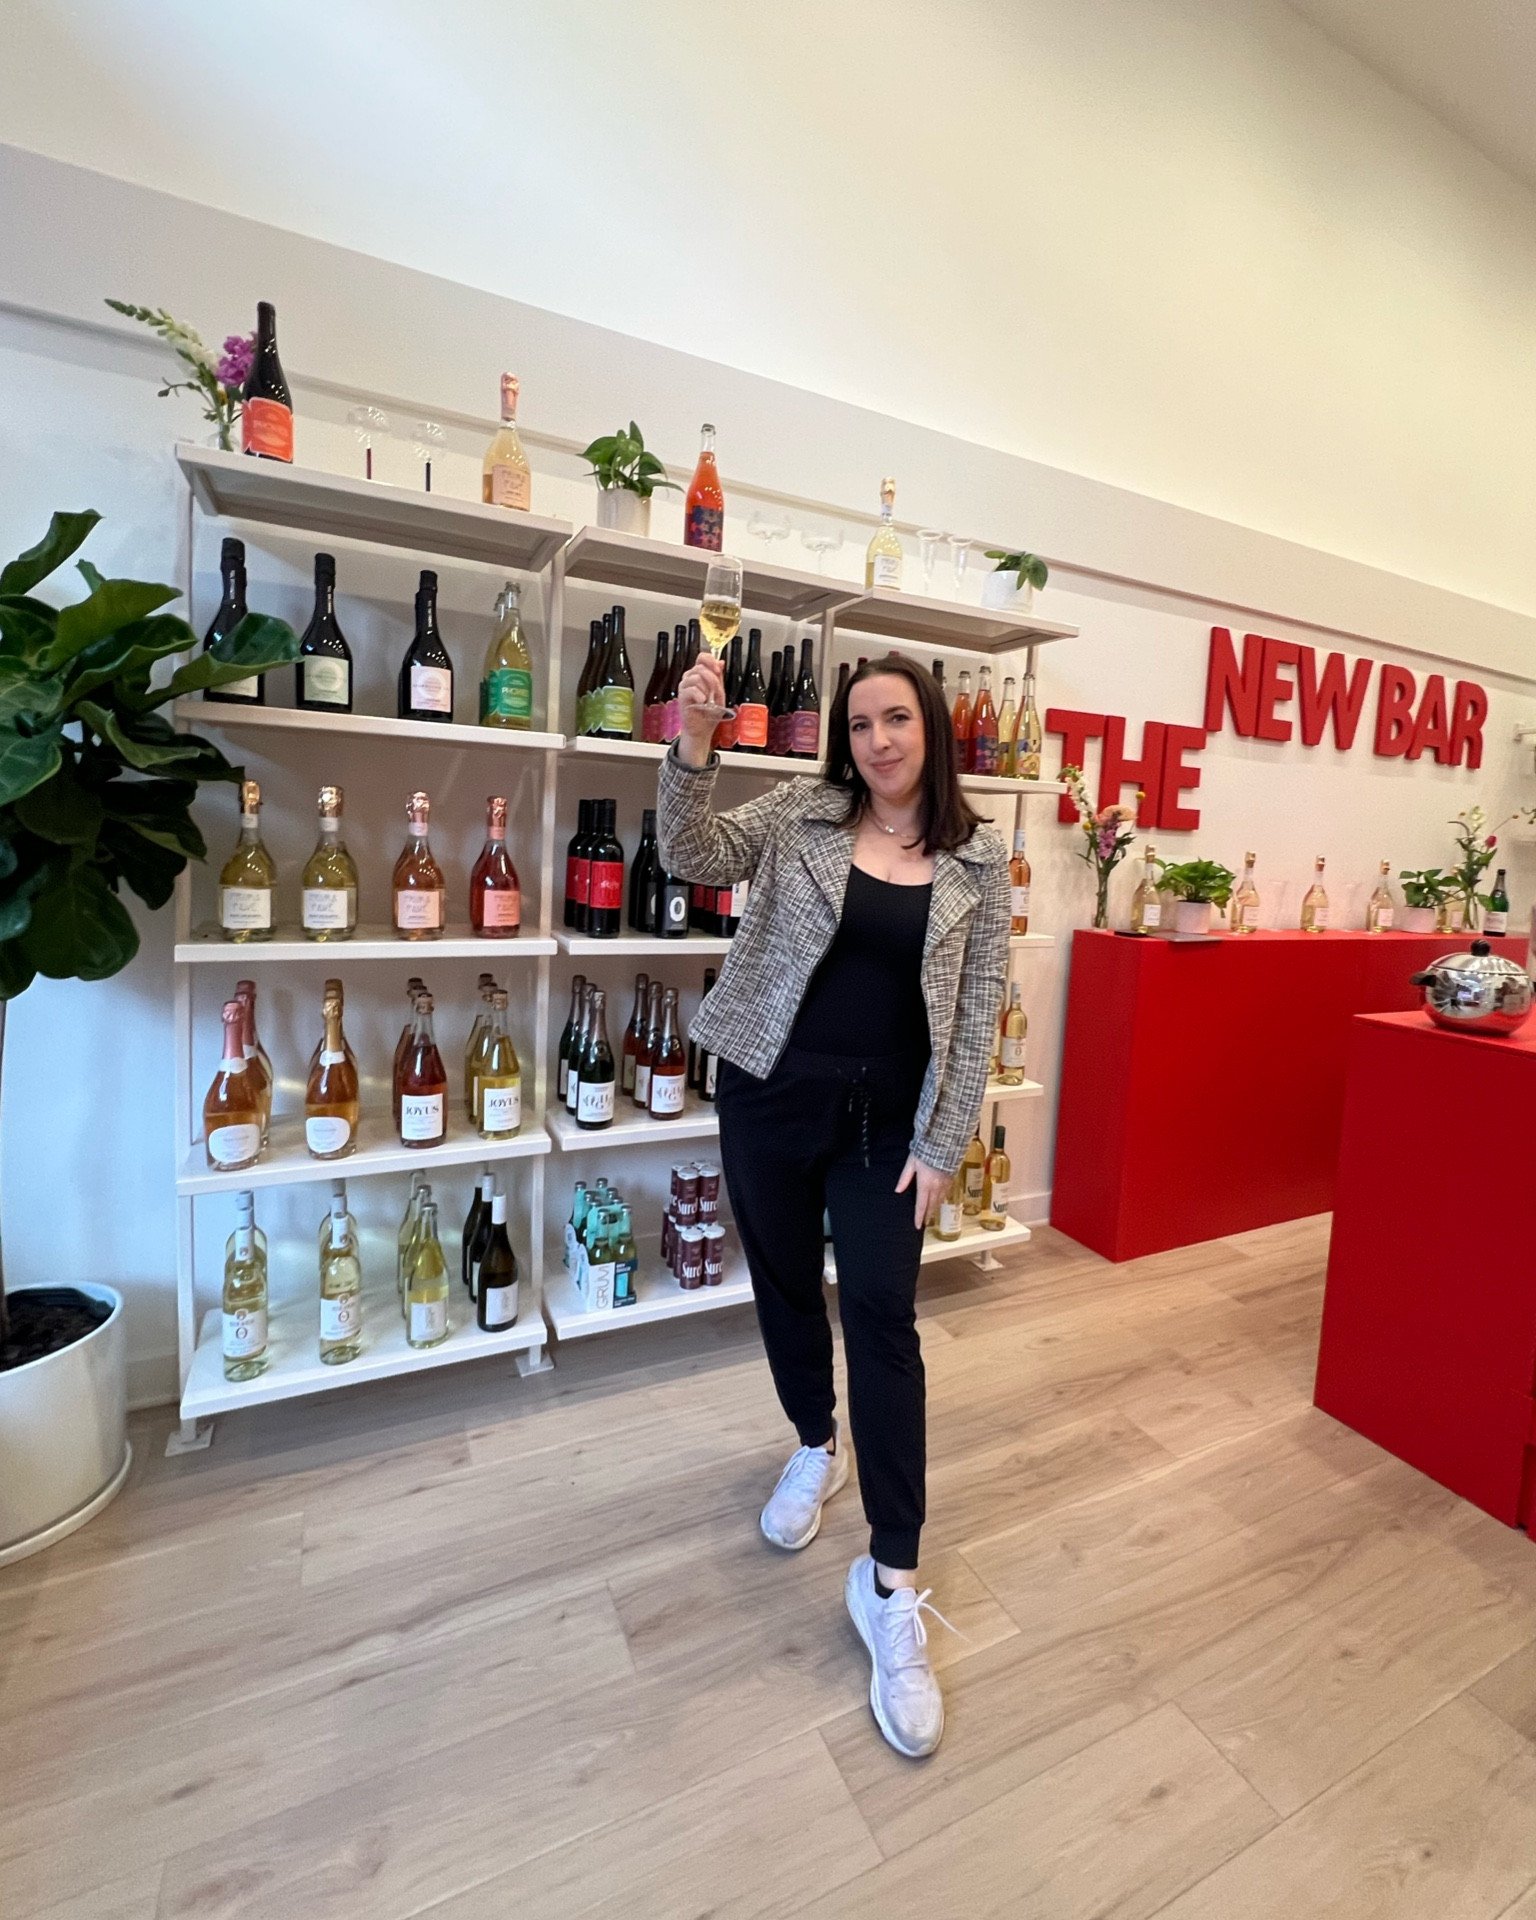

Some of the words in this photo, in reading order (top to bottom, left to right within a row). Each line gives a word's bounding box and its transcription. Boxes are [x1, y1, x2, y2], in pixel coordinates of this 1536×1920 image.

[1045, 708, 1207, 831] THE
[1204, 626, 1373, 751] NEW
[1374, 663, 1488, 770] BAR
